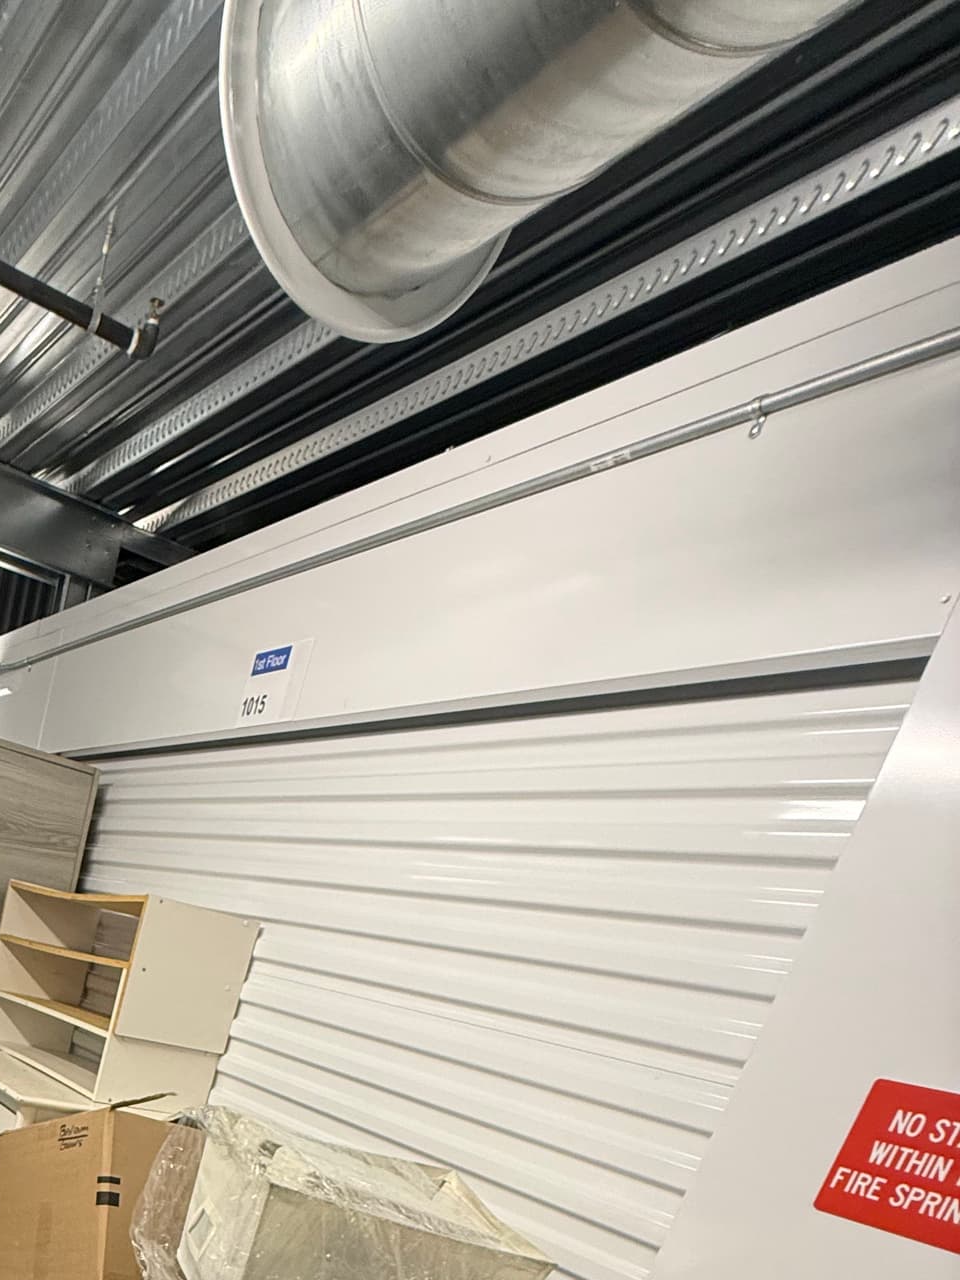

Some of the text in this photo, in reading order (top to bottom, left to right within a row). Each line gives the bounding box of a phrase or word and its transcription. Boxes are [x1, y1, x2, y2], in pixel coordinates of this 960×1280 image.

[254, 654, 286, 670] 1st Floor
[241, 694, 267, 717] 1015
[888, 1109, 960, 1149] NO ST
[868, 1140, 954, 1182] WITHIN
[830, 1166, 887, 1201] FIRE
